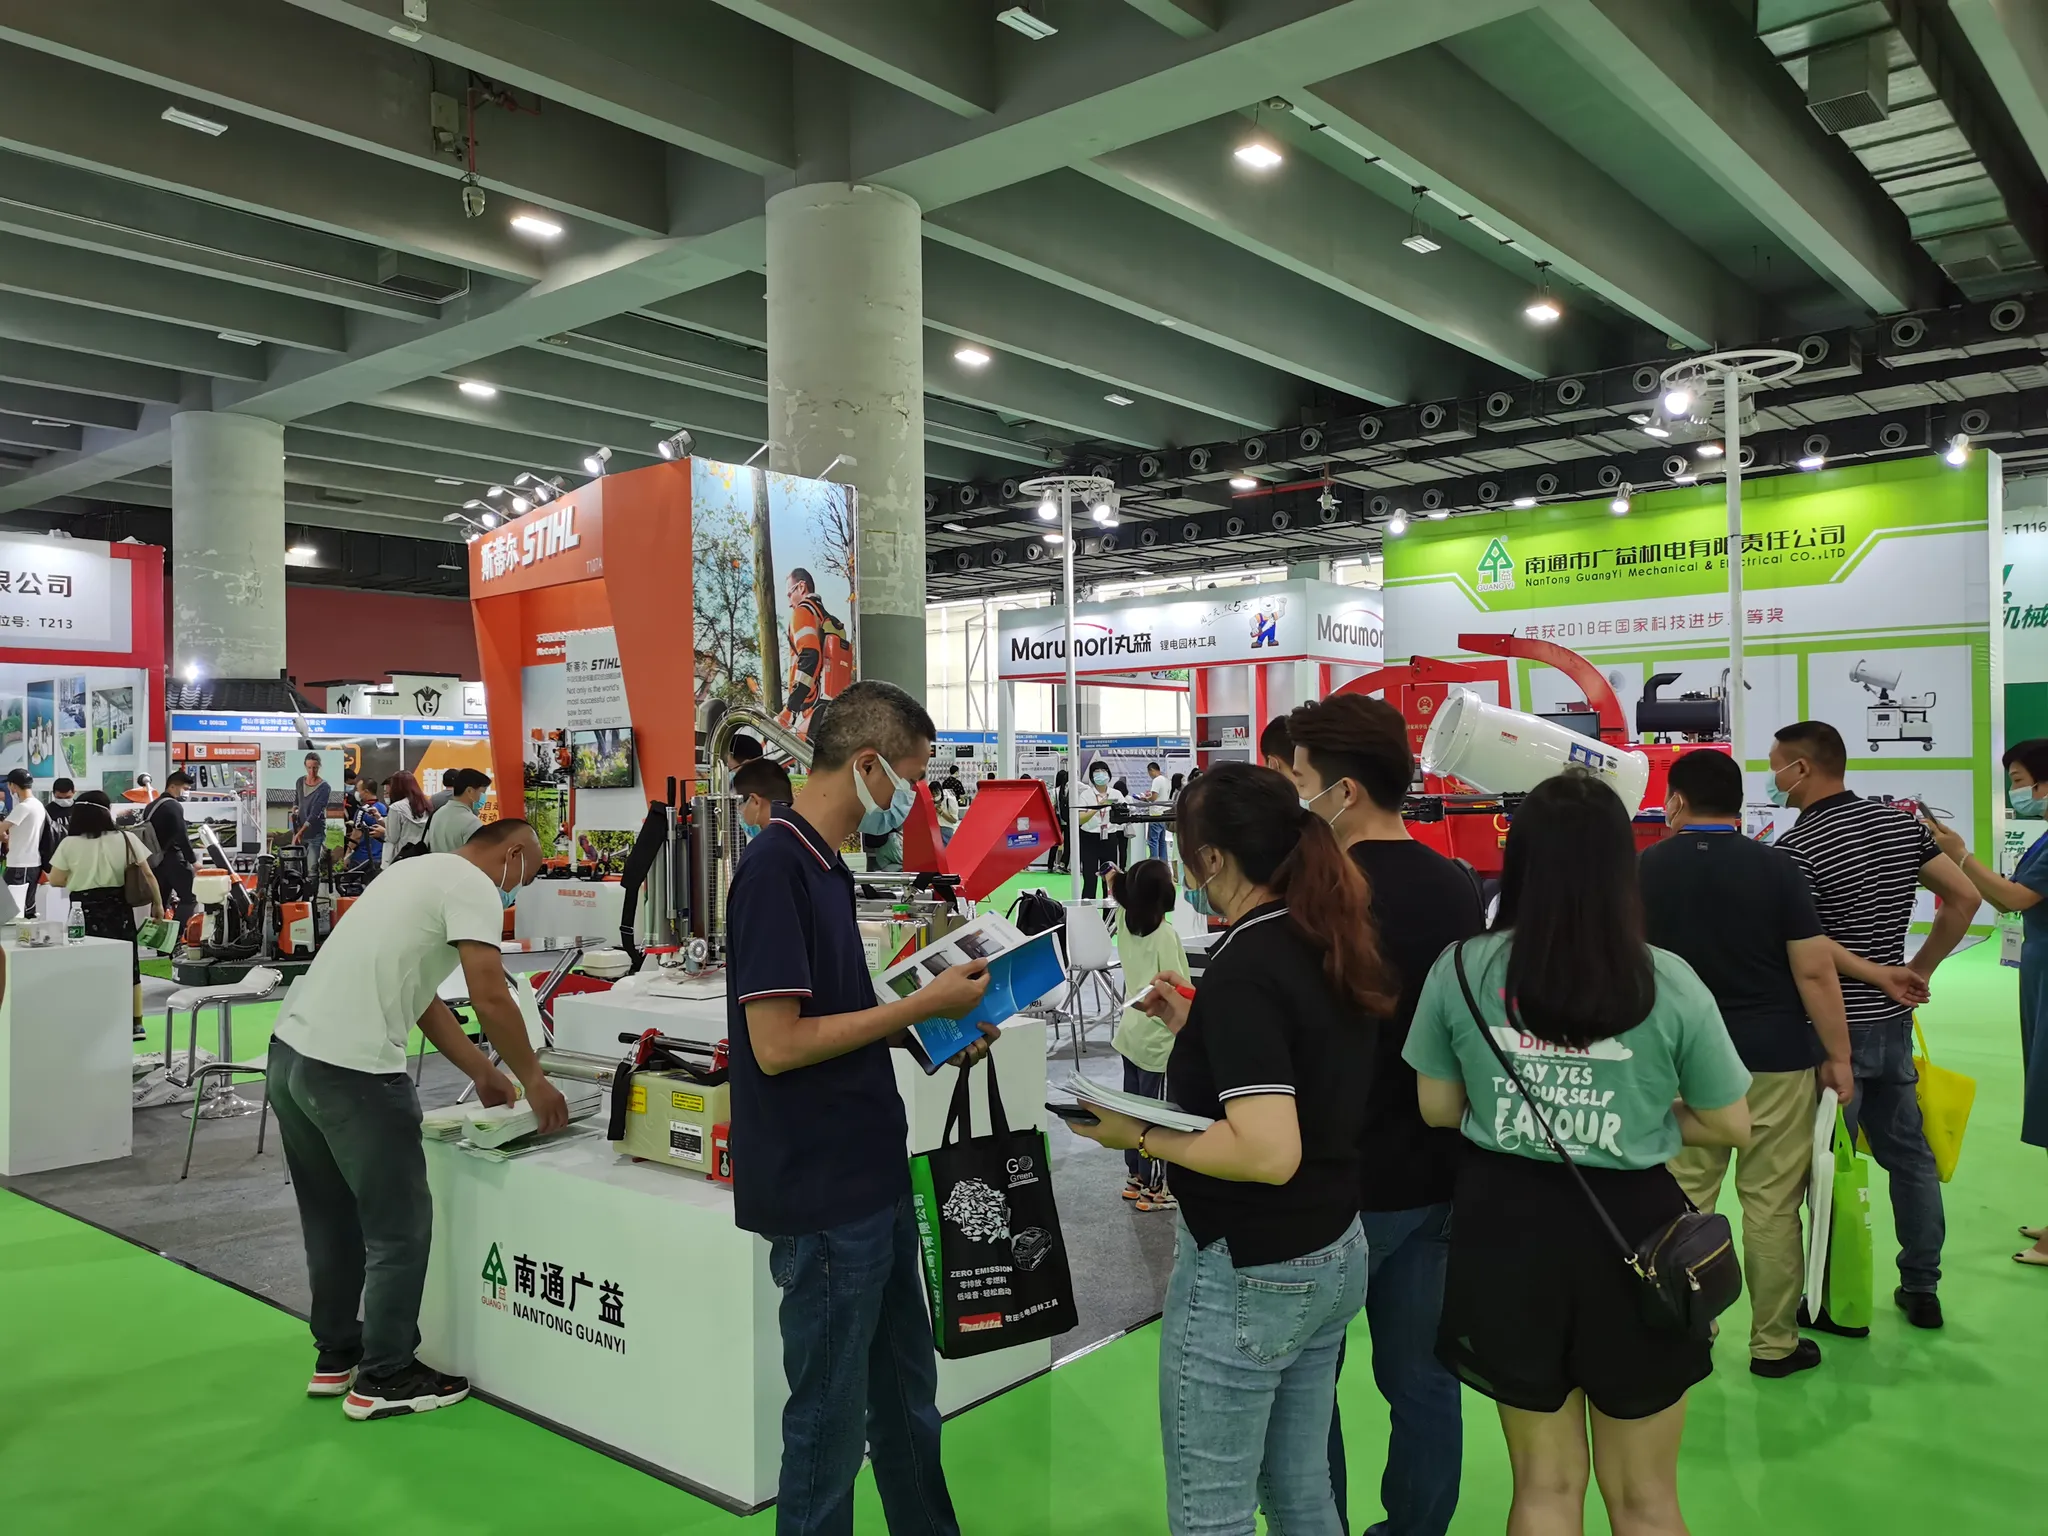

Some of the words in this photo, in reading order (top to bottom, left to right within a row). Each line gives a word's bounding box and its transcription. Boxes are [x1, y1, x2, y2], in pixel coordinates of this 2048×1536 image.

[2013, 521, 2047, 535] T116
[481, 532, 519, 582] 斯蒂尔
[522, 505, 580, 567] STIHL
[1525, 524, 1845, 575] 南通市广益机电有限责任公司
[1525, 576, 1570, 587] NanTong
[1576, 570, 1622, 582] GuangYi
[1628, 562, 1698, 577] Mechanical
[1704, 561, 1713, 570] &
[1720, 554, 1783, 569] Elctrical
[1477, 583, 1505, 592] GUANG
[1506, 582, 1515, 590] YI
[39, 617, 73, 629] T213
[1525, 607, 1784, 639] 荣获2018年国家科技进步等奖
[1011, 628, 1113, 661] Marumori
[1115, 632, 1152, 655] 丸森
[1160, 635, 1217, 651] 锂电园林工具
[591, 657, 620, 670] STIHL
[577, 687, 587, 695] only
[1513, 1060, 1549, 1084] SAY
[1555, 1065, 1593, 1085] YES
[1010, 1171, 1034, 1183] Green
[950, 1269, 973, 1278] ZERO
[975, 1265, 1013, 1276] EMISSION
[513, 1253, 626, 1329] 南通广益
[481, 1295, 502, 1310] GUANG
[502, 1303, 508, 1312] YI
[513, 1301, 573, 1336] NANTONG
[576, 1323, 626, 1355] GUANYI
